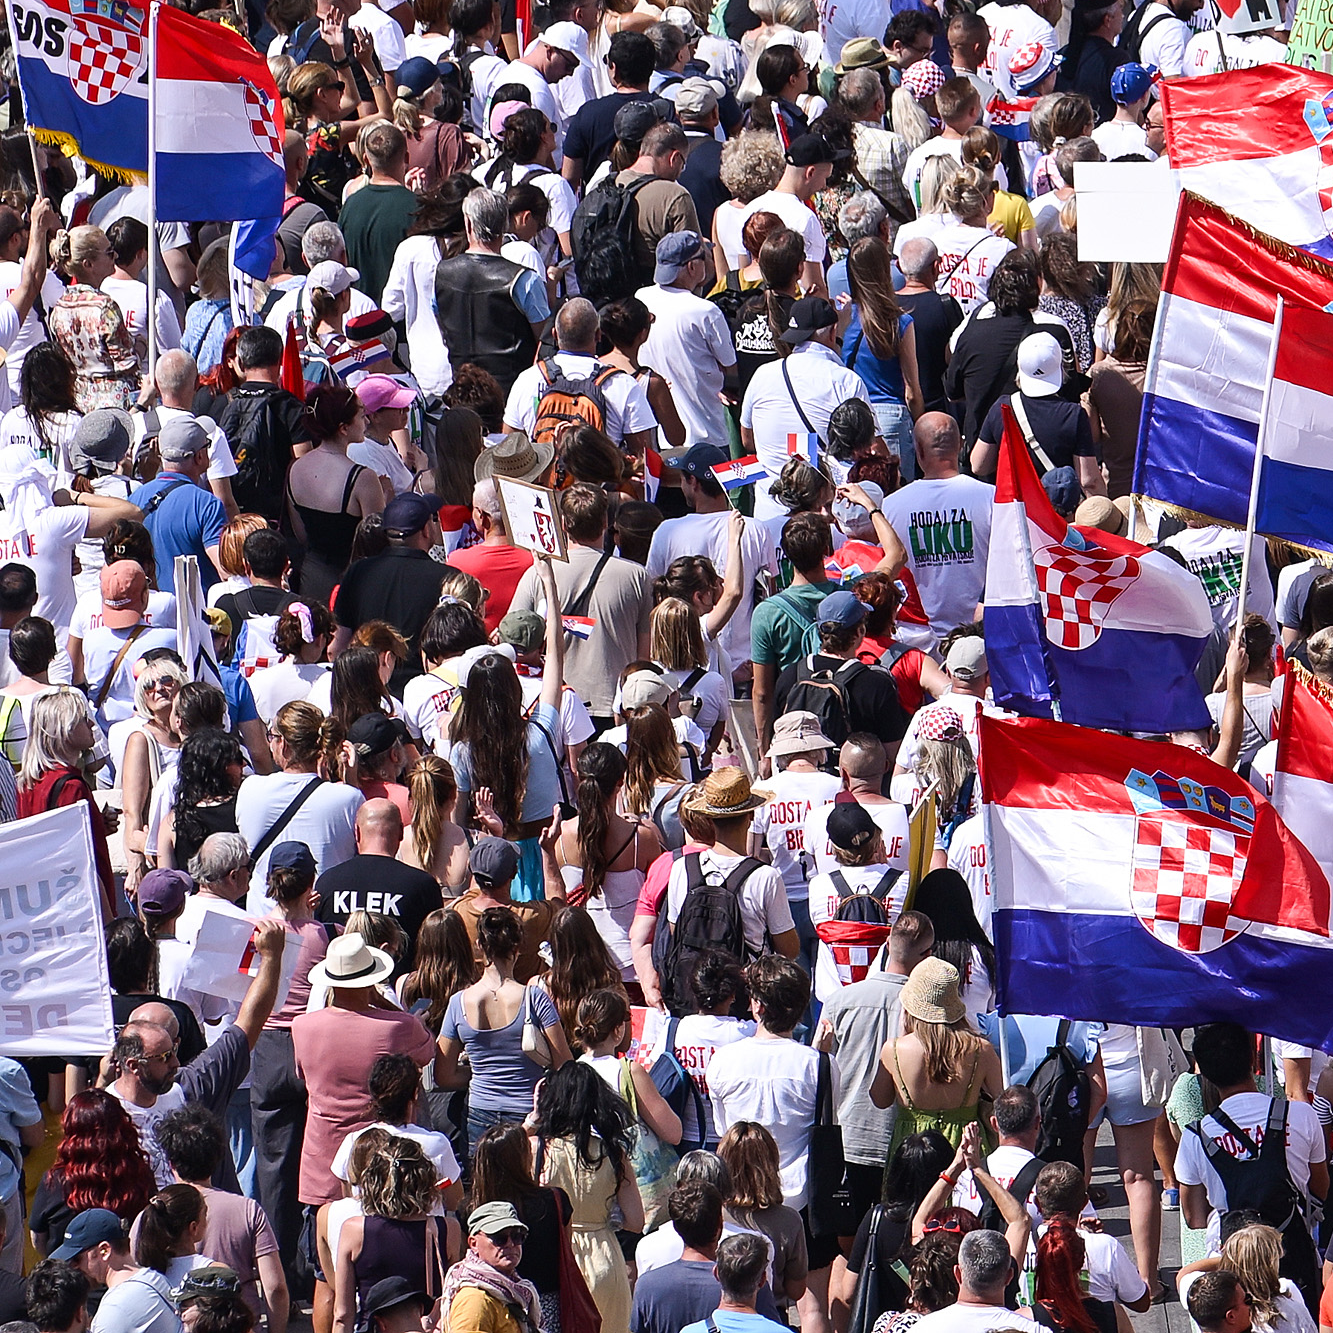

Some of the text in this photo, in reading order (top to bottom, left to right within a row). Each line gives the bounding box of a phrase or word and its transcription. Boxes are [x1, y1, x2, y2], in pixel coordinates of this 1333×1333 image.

[911, 509, 967, 529] HODAJ ZA
[909, 521, 974, 555] LIKU
[334, 890, 403, 916] KLEK
